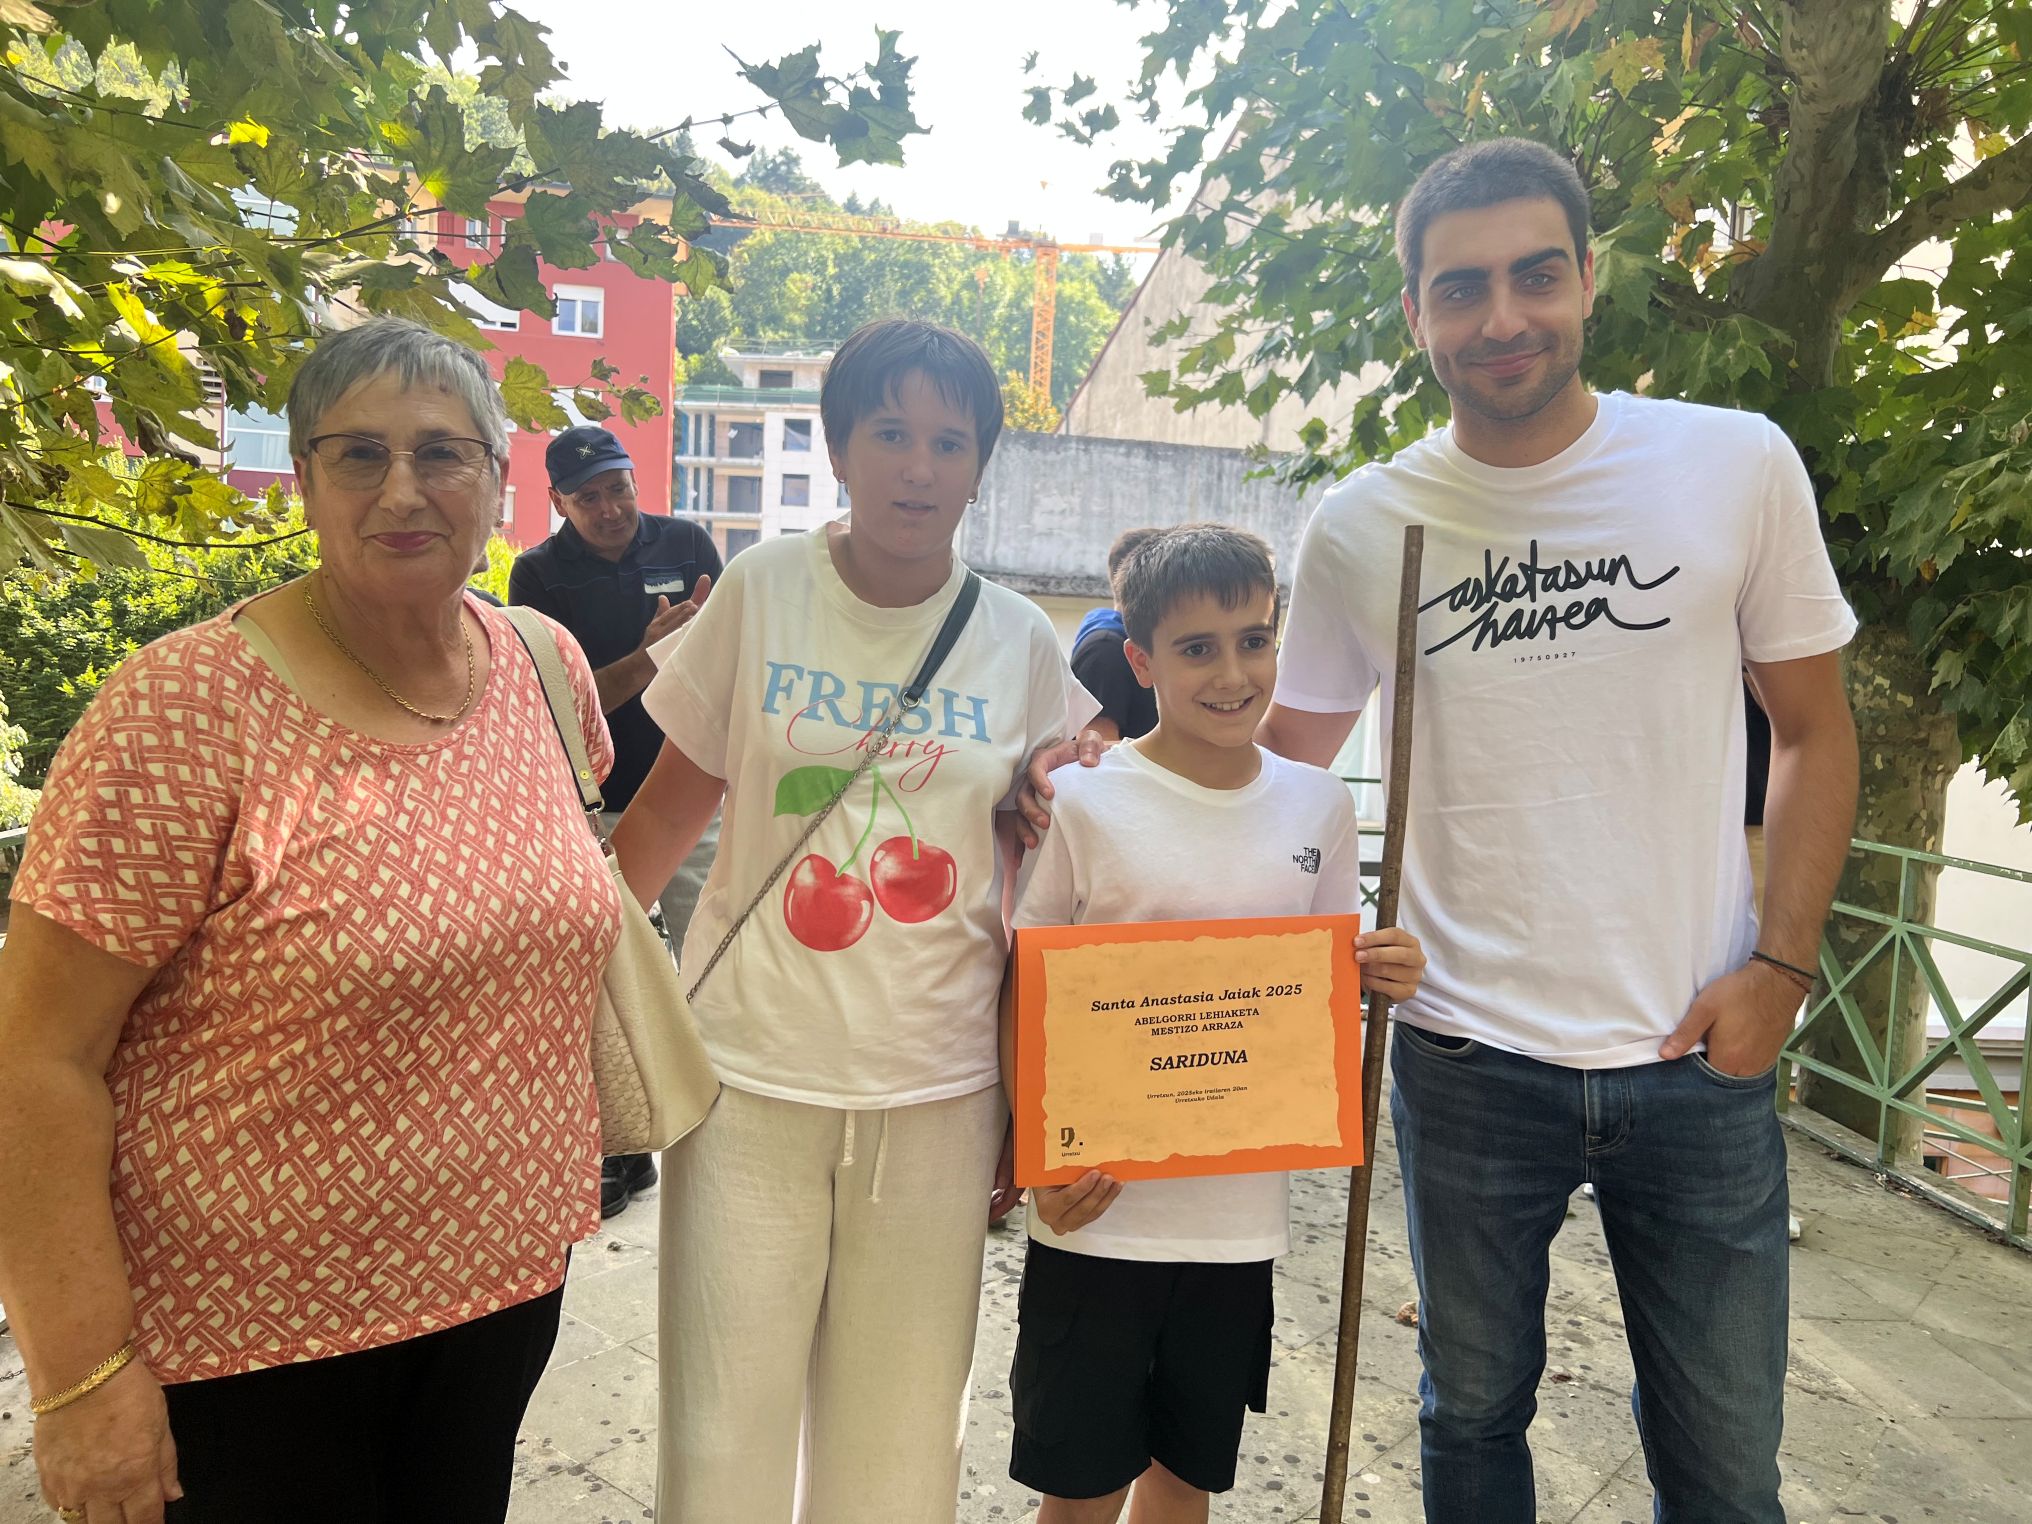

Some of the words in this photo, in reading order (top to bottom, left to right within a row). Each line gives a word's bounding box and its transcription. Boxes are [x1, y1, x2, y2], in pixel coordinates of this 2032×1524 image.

[1513, 651, 1576, 664] 19750927
[761, 661, 992, 744] FRESH
[786, 698, 960, 793] Cherry
[1292, 854, 1316, 865] NORTH
[1303, 847, 1317, 857] THE
[1300, 864, 1315, 874] FACE
[1091, 998, 1136, 1012] Santa
[1139, 991, 1214, 1008] Anastasia
[1218, 986, 1261, 1001] Jaiak
[1265, 983, 1303, 997] 2025
[1134, 1012, 1197, 1026] ABELGORRI
[1199, 1007, 1260, 1021] LEHIAKETA
[1151, 1024, 1198, 1037] MESTIZO
[1201, 1020, 1244, 1032] ARRAZA
[1149, 1049, 1249, 1071] SARIDUNA
